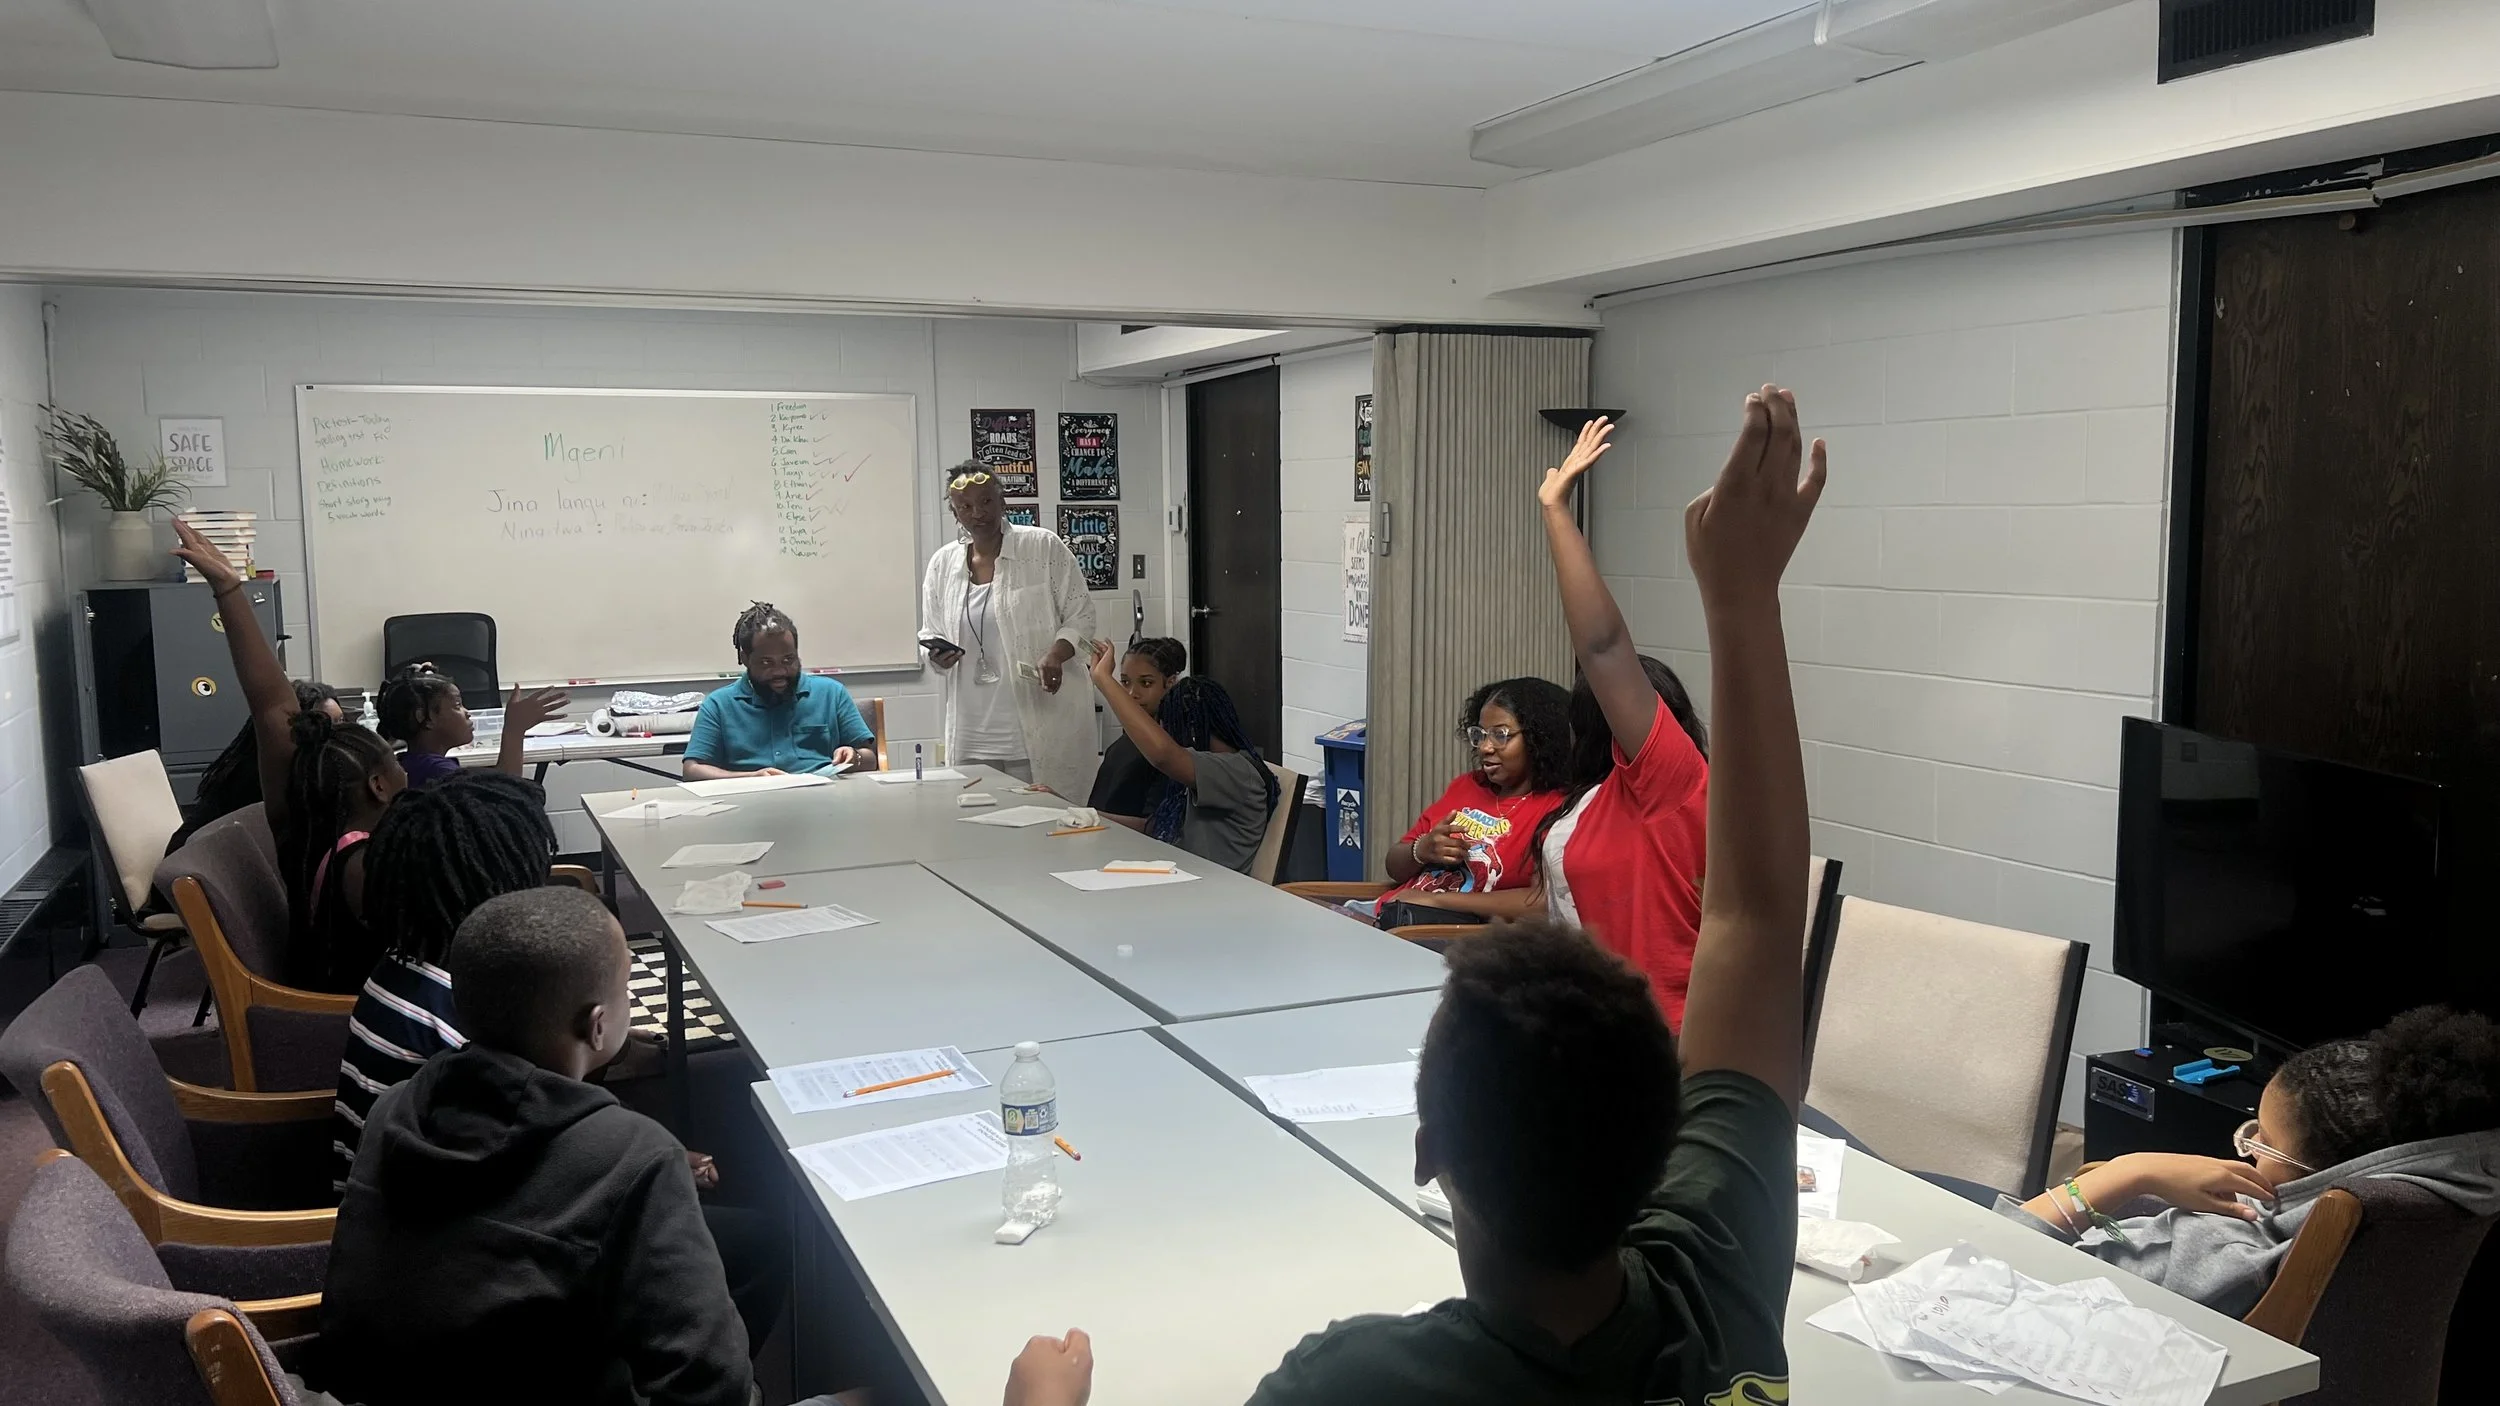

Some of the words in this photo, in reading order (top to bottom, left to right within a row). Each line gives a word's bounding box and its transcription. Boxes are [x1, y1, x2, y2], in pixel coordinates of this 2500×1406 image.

[169, 433, 213, 453] SAFE
[989, 432, 1018, 444] ROADS
[544, 432, 626, 484] Mgeni
[984, 446, 1004, 456] often
[1070, 448, 1096, 457] CHANCE
[1097, 448, 1106, 457] TO
[171, 456, 214, 473] SPACE
[994, 461, 1034, 474] autiful
[317, 477, 382, 493] Definitions
[486, 488, 538, 513] Jina
[1071, 518, 1108, 533] Little
[1078, 543, 1101, 553] MAKE
[1075, 554, 1105, 570] BIG
